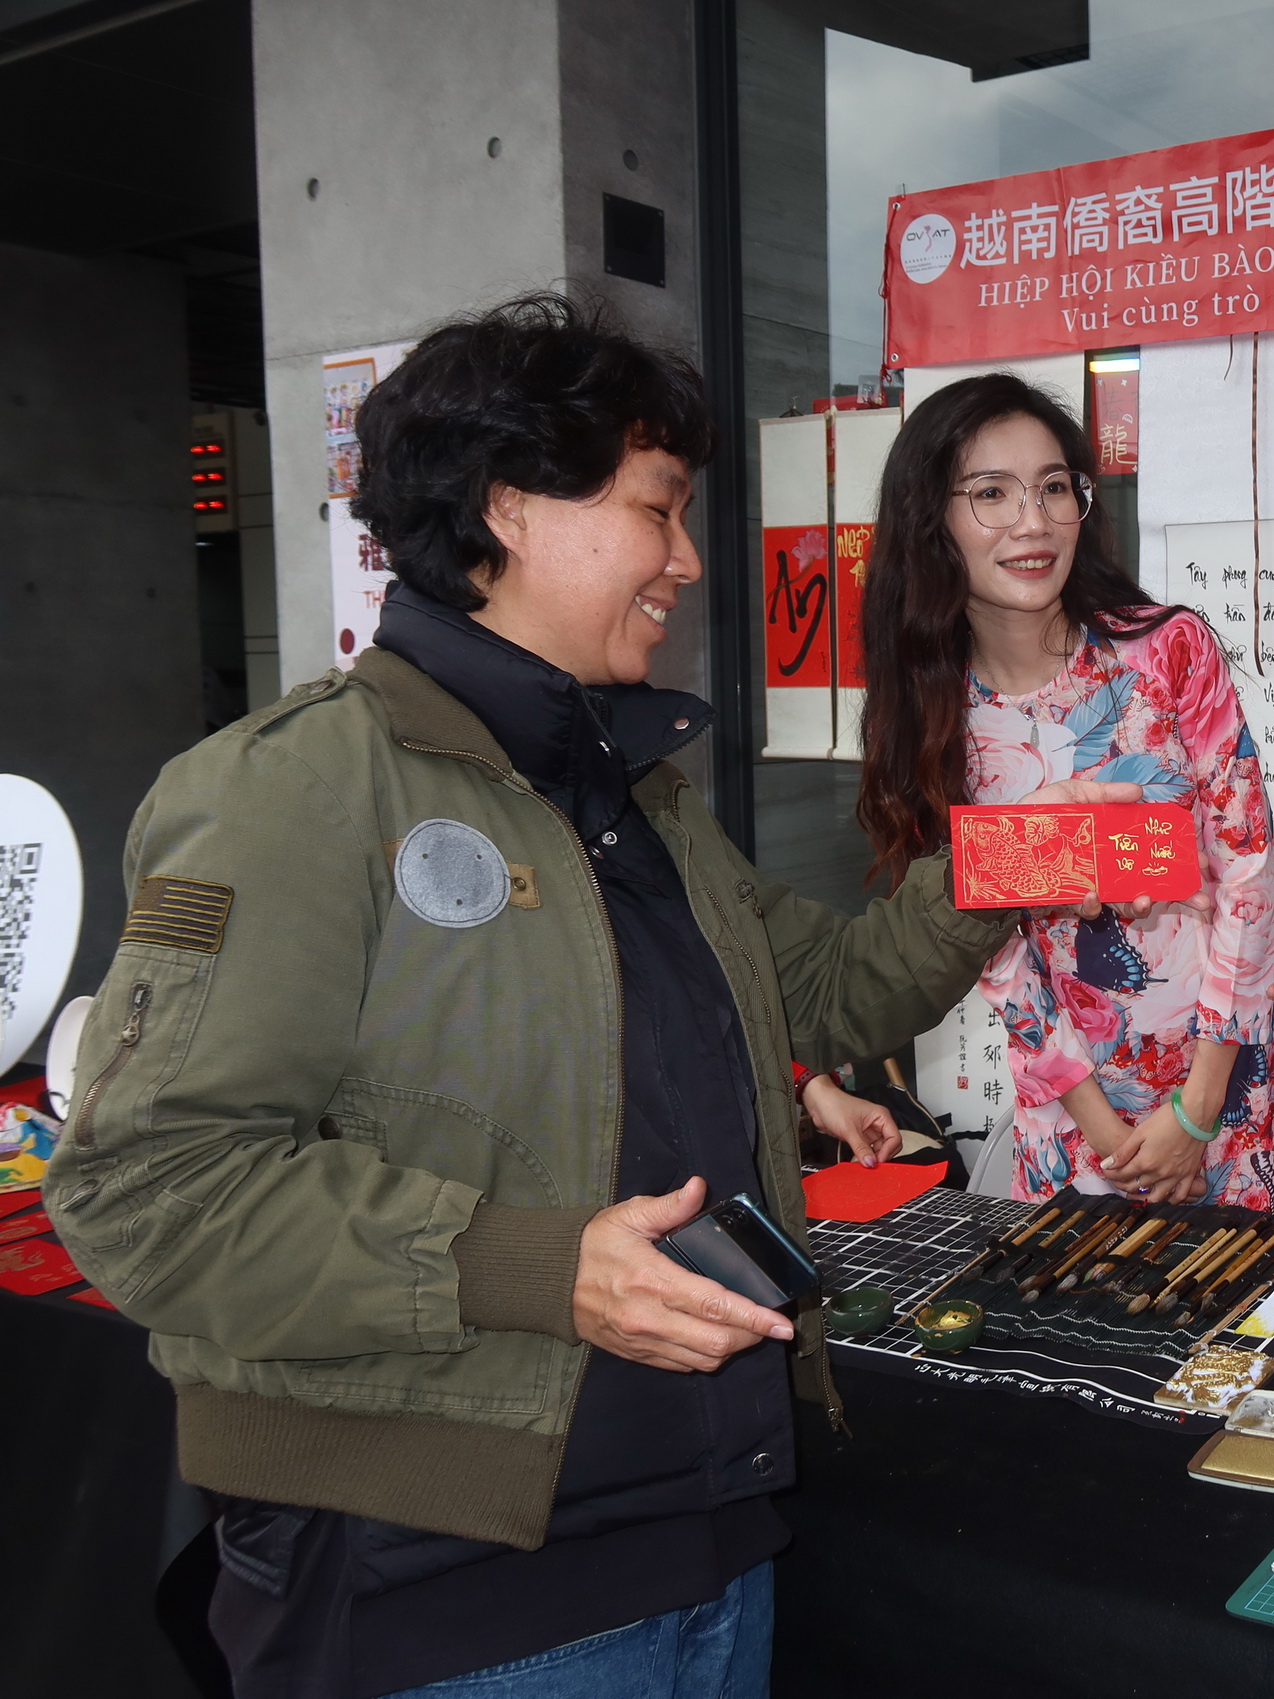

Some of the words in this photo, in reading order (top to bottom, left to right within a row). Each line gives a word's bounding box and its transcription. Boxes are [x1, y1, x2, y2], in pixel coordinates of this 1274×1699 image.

[979, 275, 1049, 309] HIỆP
[1060, 262, 1113, 298] HỘI
[1124, 252, 1199, 290] KIỀU
[1061, 300, 1109, 332] Vui
[1122, 292, 1200, 327] cùng
[1213, 284, 1259, 315] trò
[1100, 423, 1137, 465] 龍
